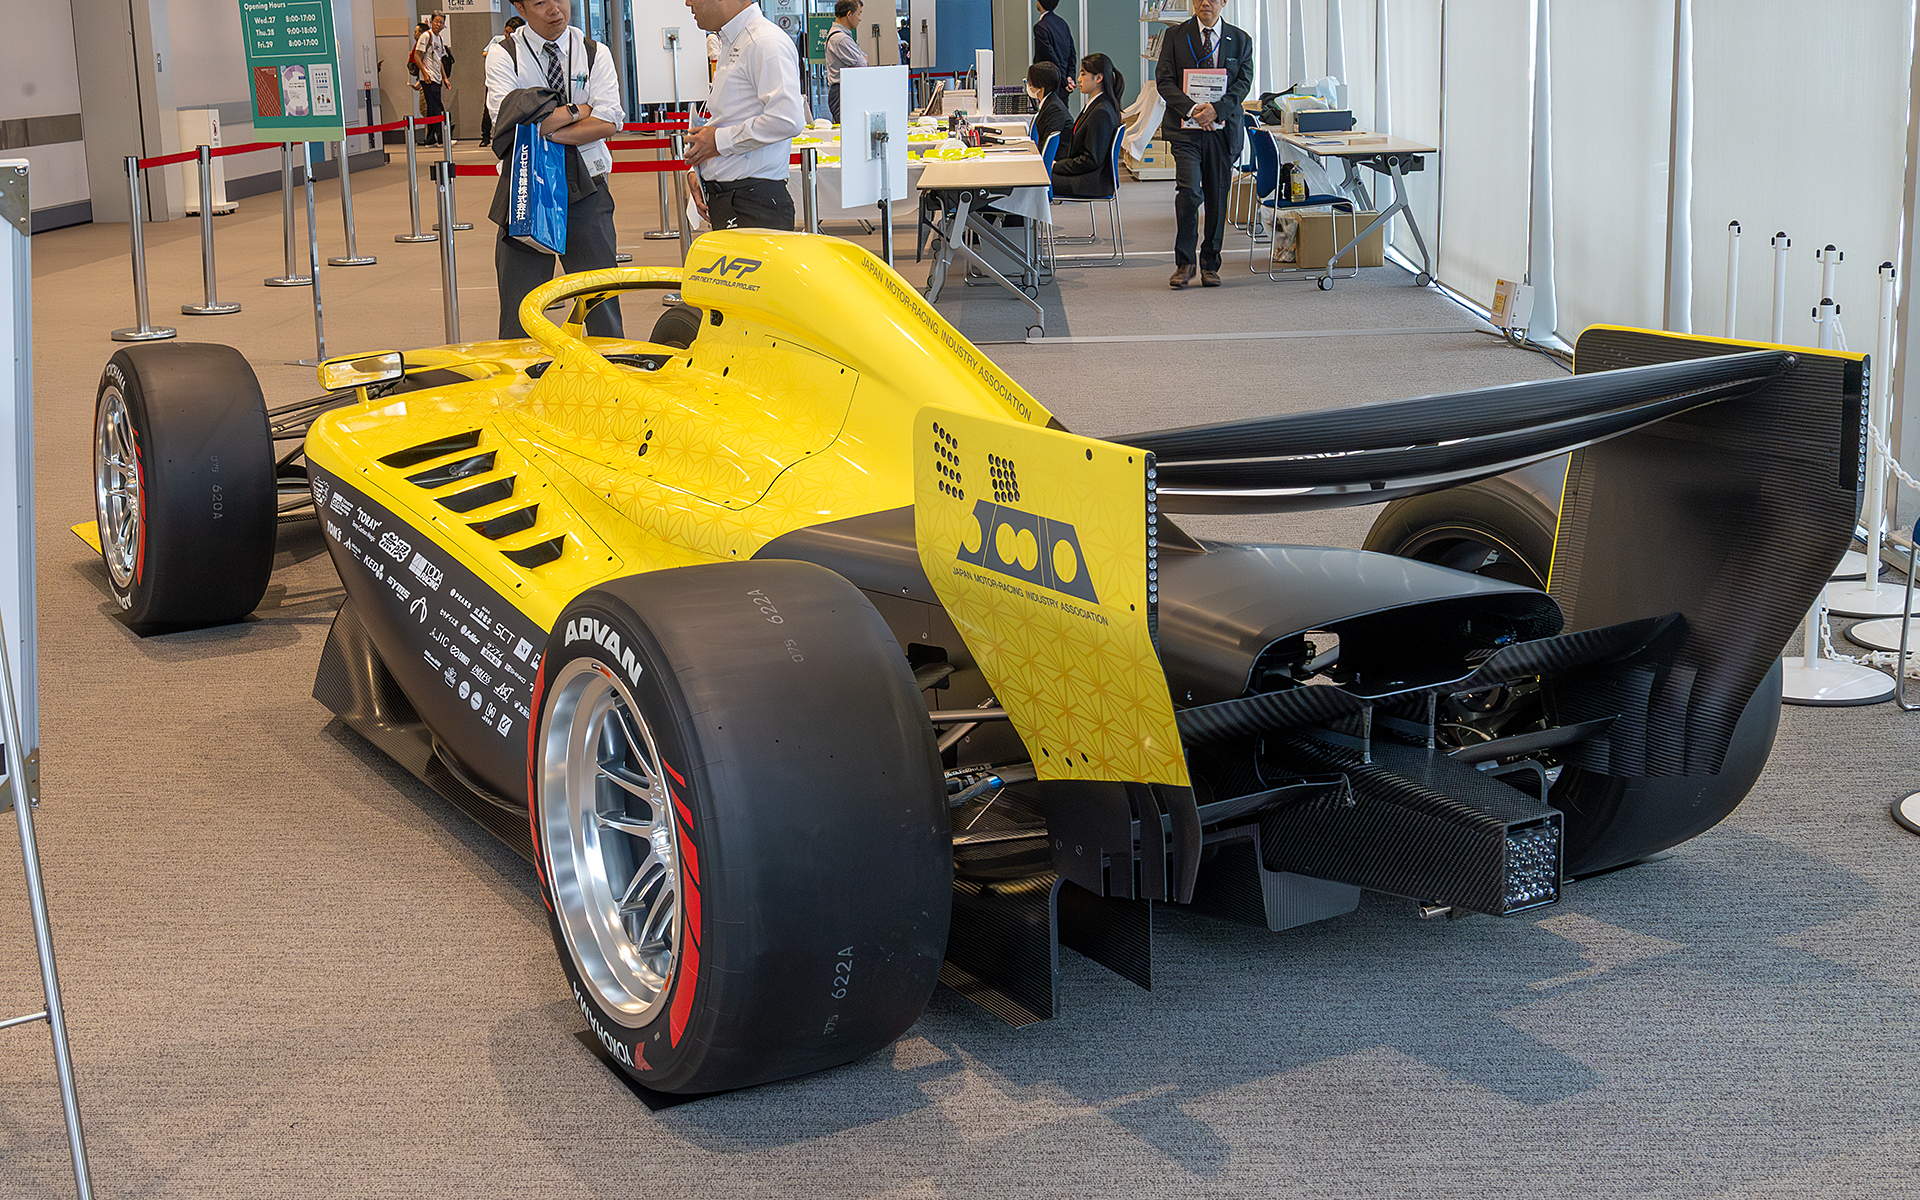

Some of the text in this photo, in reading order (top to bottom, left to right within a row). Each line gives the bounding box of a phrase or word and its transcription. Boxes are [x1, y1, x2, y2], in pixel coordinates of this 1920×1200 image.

[244, 1, 286, 12] Opening Hours
[254, 14, 316, 24] Wed.27 8:00-17:00
[286, 26, 317, 35] 9:00-18:00
[288, 38, 319, 47] 8:00-17:00
[712, 278, 736, 288] FORMULA
[735, 282, 761, 292] PROJECT
[861, 257, 1032, 422] JAPAN MOTOR-RACING INDUSTRY ASSOCIATION
[212, 484, 223, 519] 620A
[363, 554, 379, 573] KED
[425, 562, 444, 586] TODA
[420, 572, 440, 592] RACING
[454, 592, 472, 609] PEAKS
[746, 588, 784, 625] 622A
[952, 566, 1109, 627] JAPAN MOTOR-RACING INDUSTRY ASSOCIATION
[492, 622, 516, 645] SCT
[486, 641, 505, 659] サンアイ
[564, 617, 643, 688] ADVAN
[831, 946, 854, 999] 622A
[573, 981, 635, 1068] YOKOHAMA
